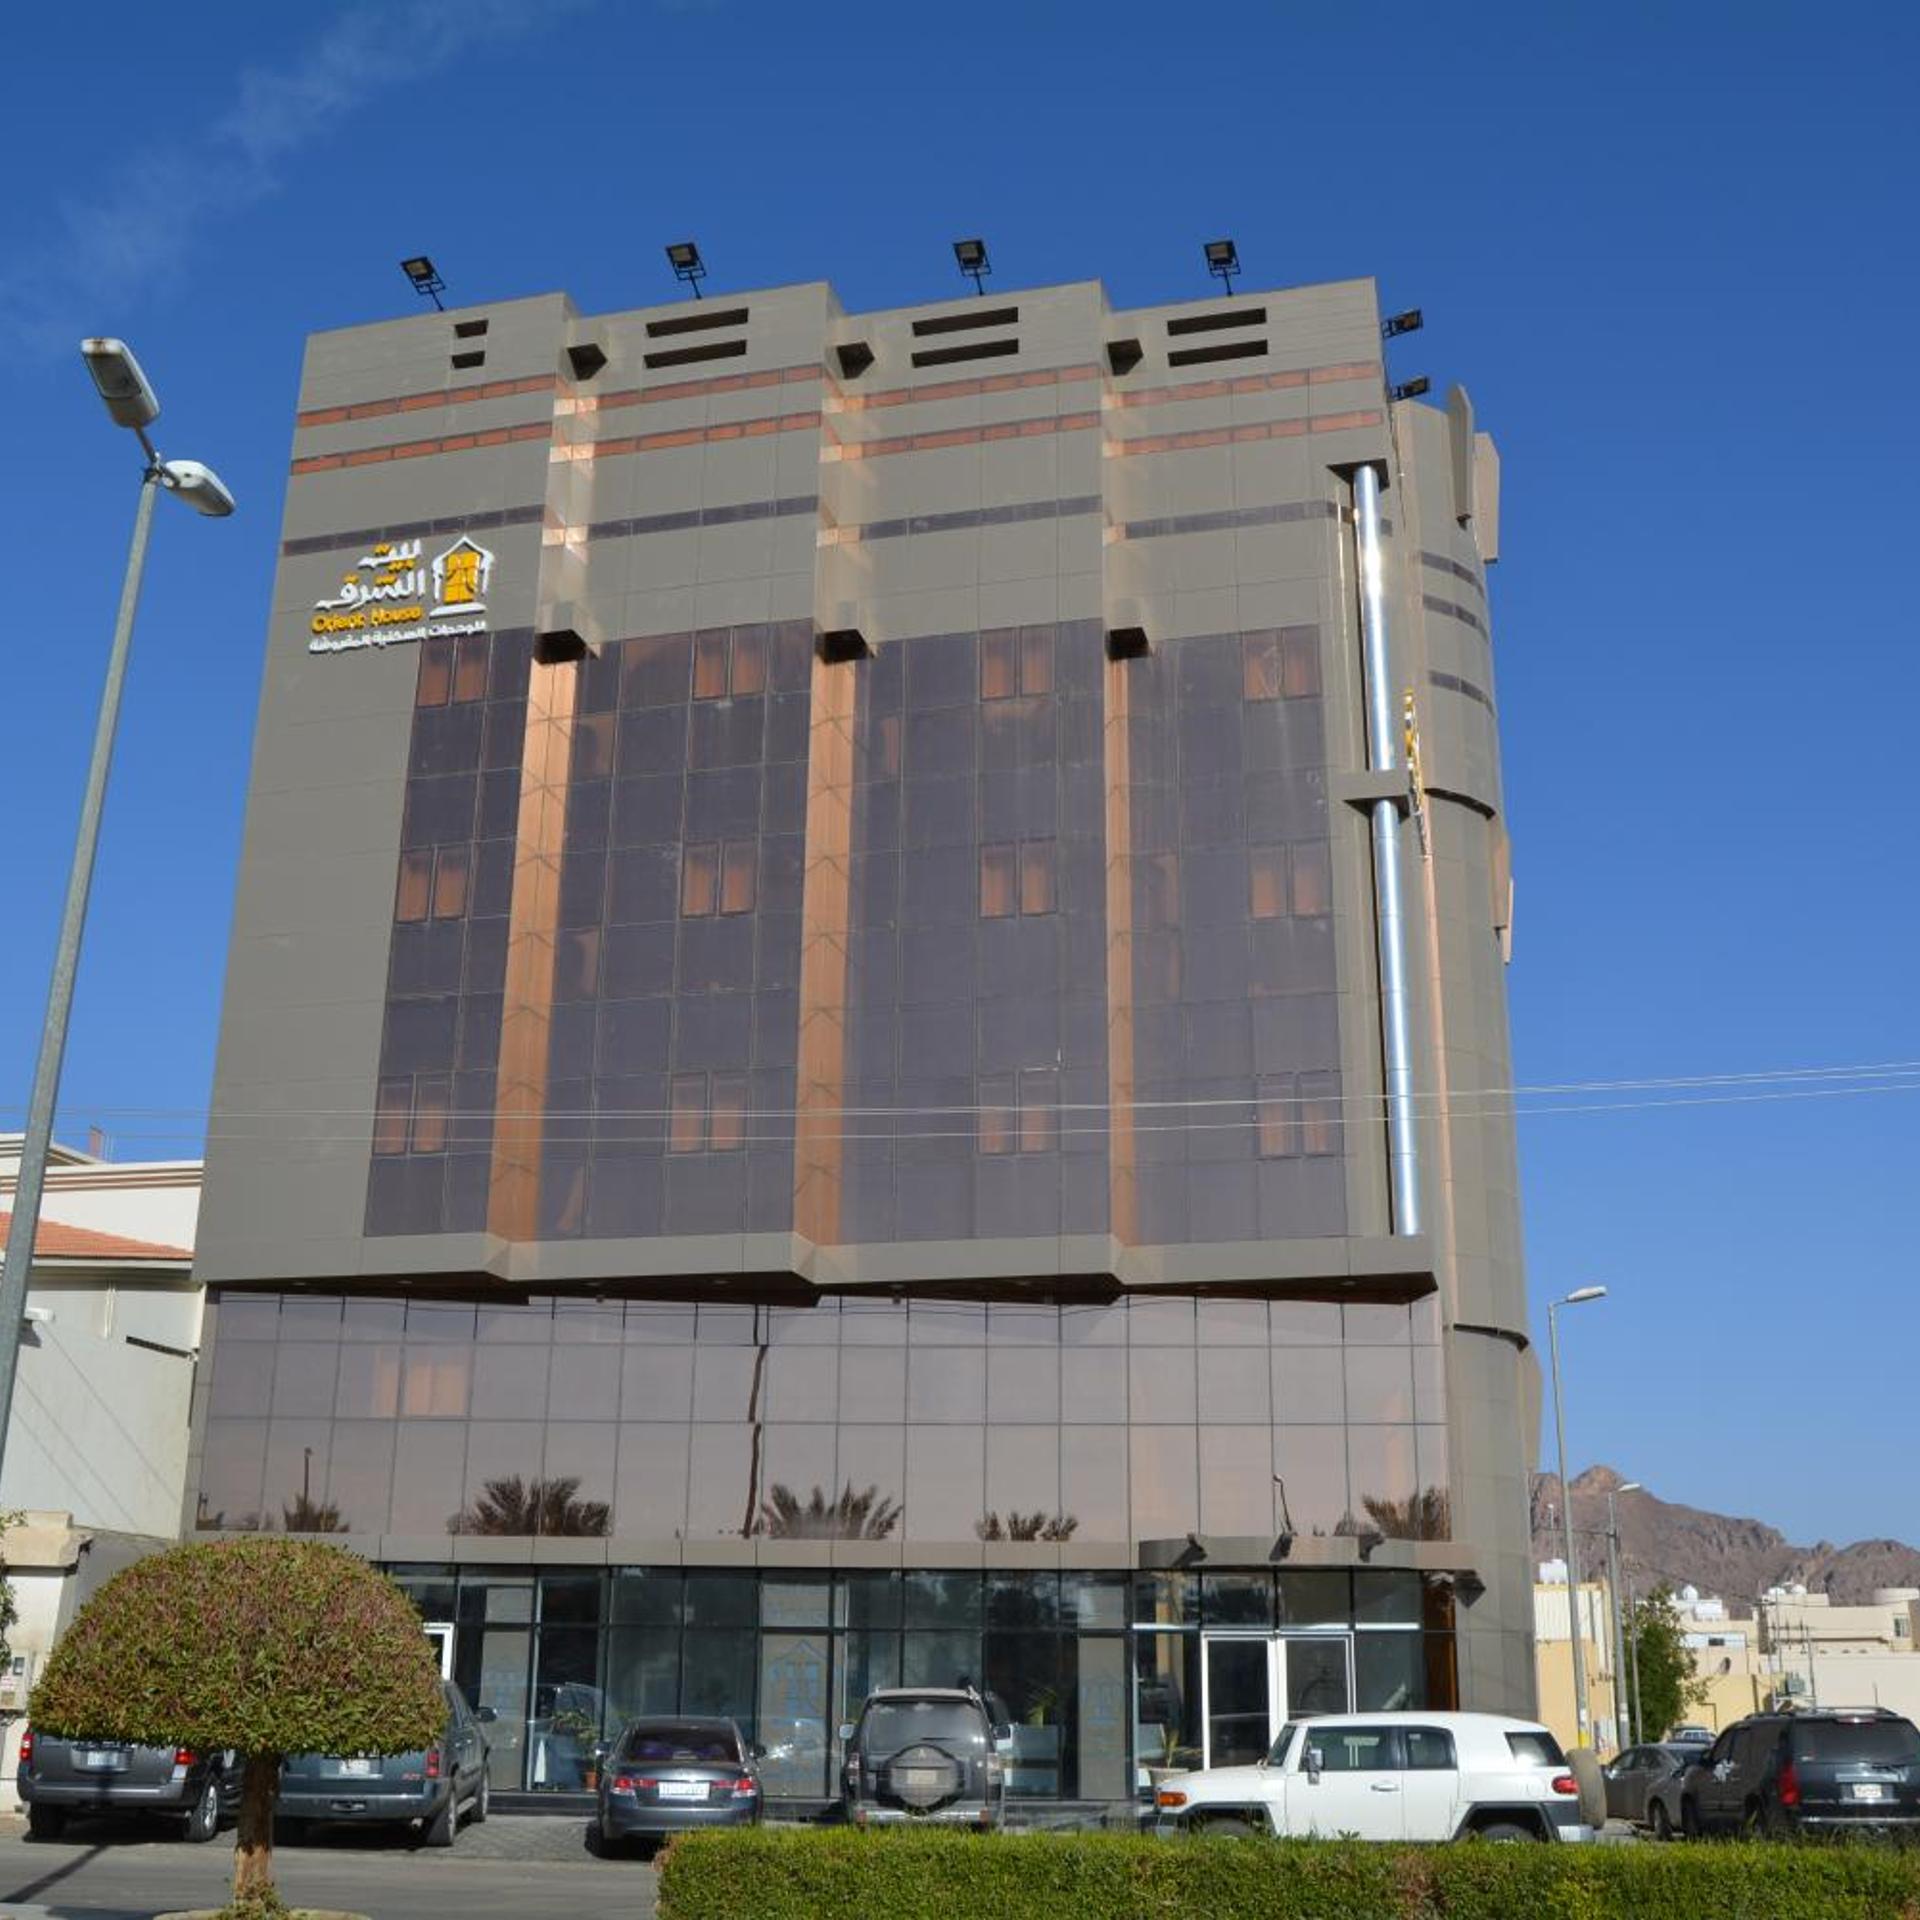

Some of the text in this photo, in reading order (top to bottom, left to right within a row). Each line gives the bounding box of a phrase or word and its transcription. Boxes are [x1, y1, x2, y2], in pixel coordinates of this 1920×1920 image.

[358, 538, 422, 572] بيت
[314, 569, 426, 610] الشرق
[312, 606, 423, 633] Orient House
